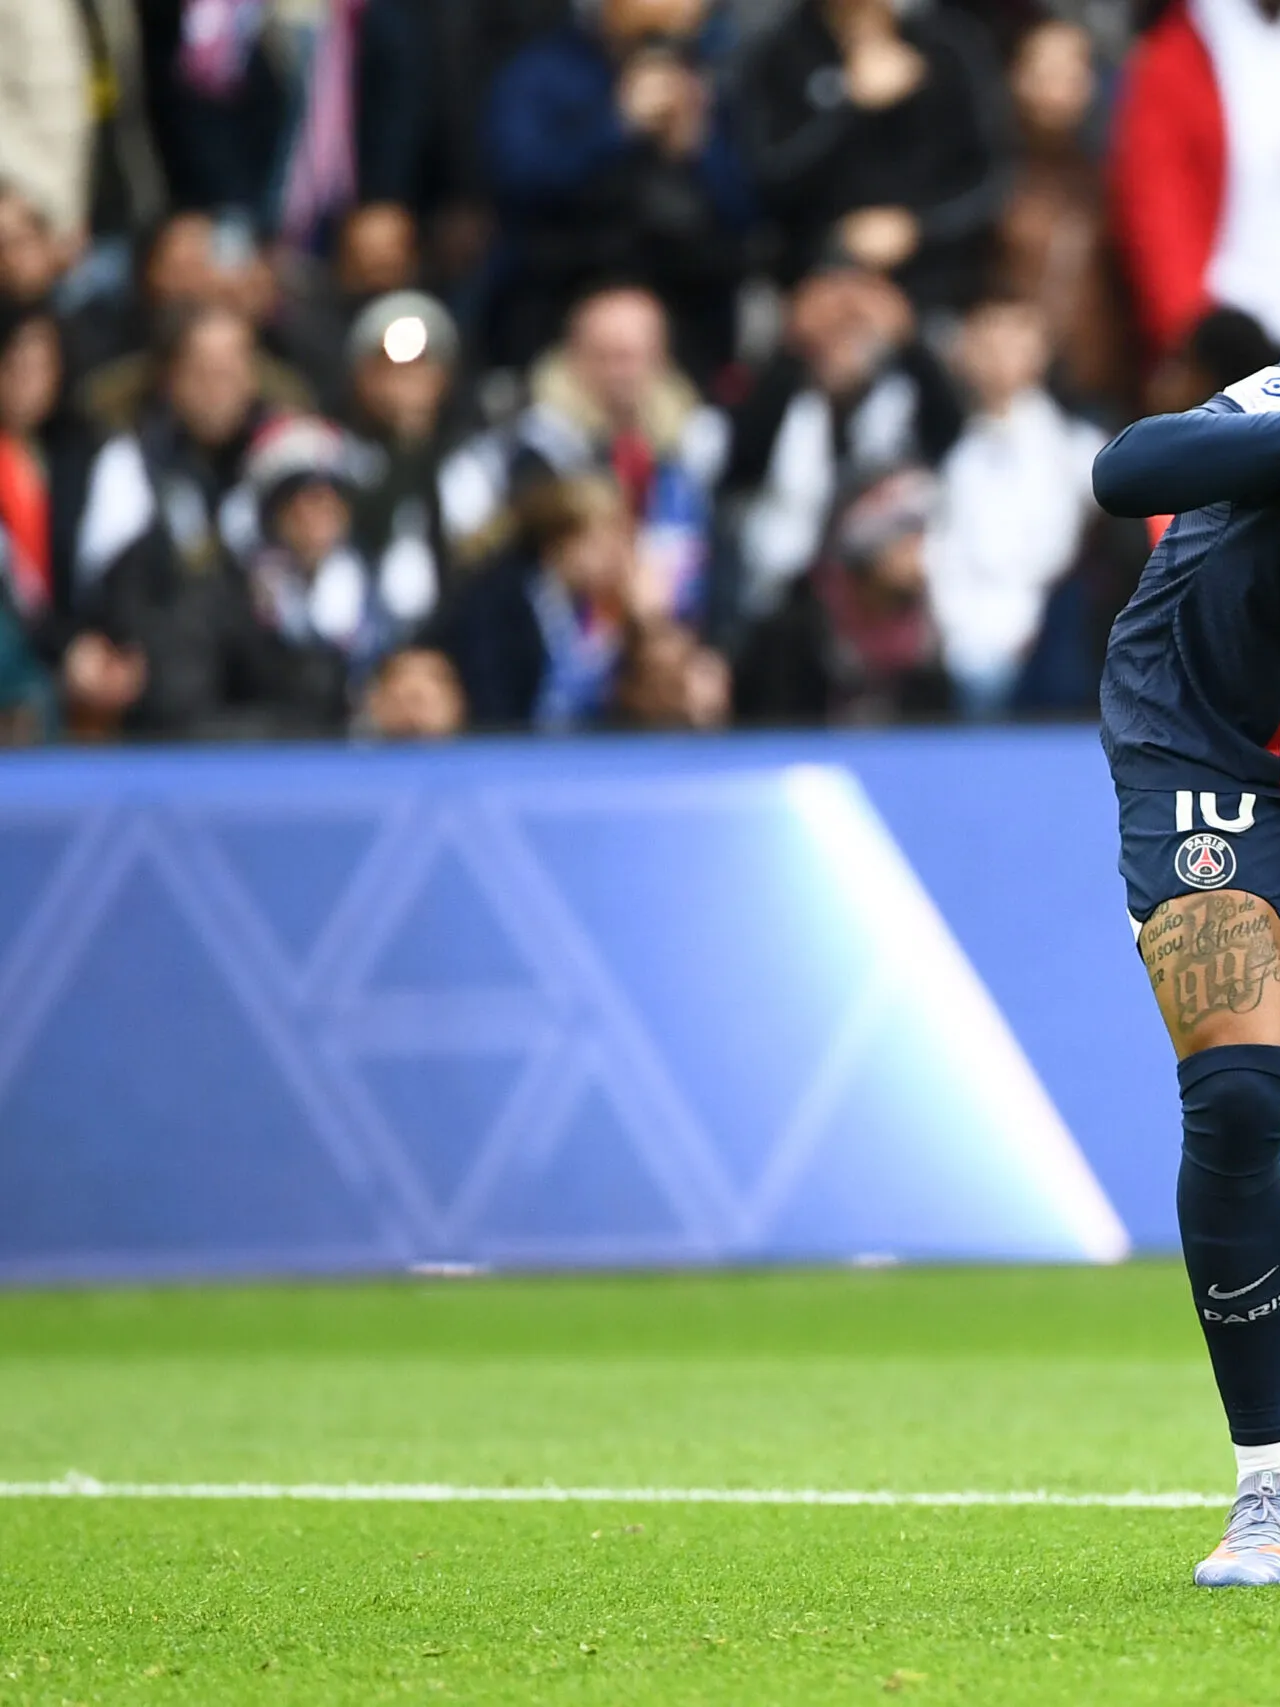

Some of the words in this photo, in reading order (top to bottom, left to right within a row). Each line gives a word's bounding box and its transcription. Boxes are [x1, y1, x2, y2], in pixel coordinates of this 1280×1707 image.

[1176, 791, 1256, 833] 10
[1185, 836, 1226, 851] PARIS
[1157, 936, 1183, 961] SOU
